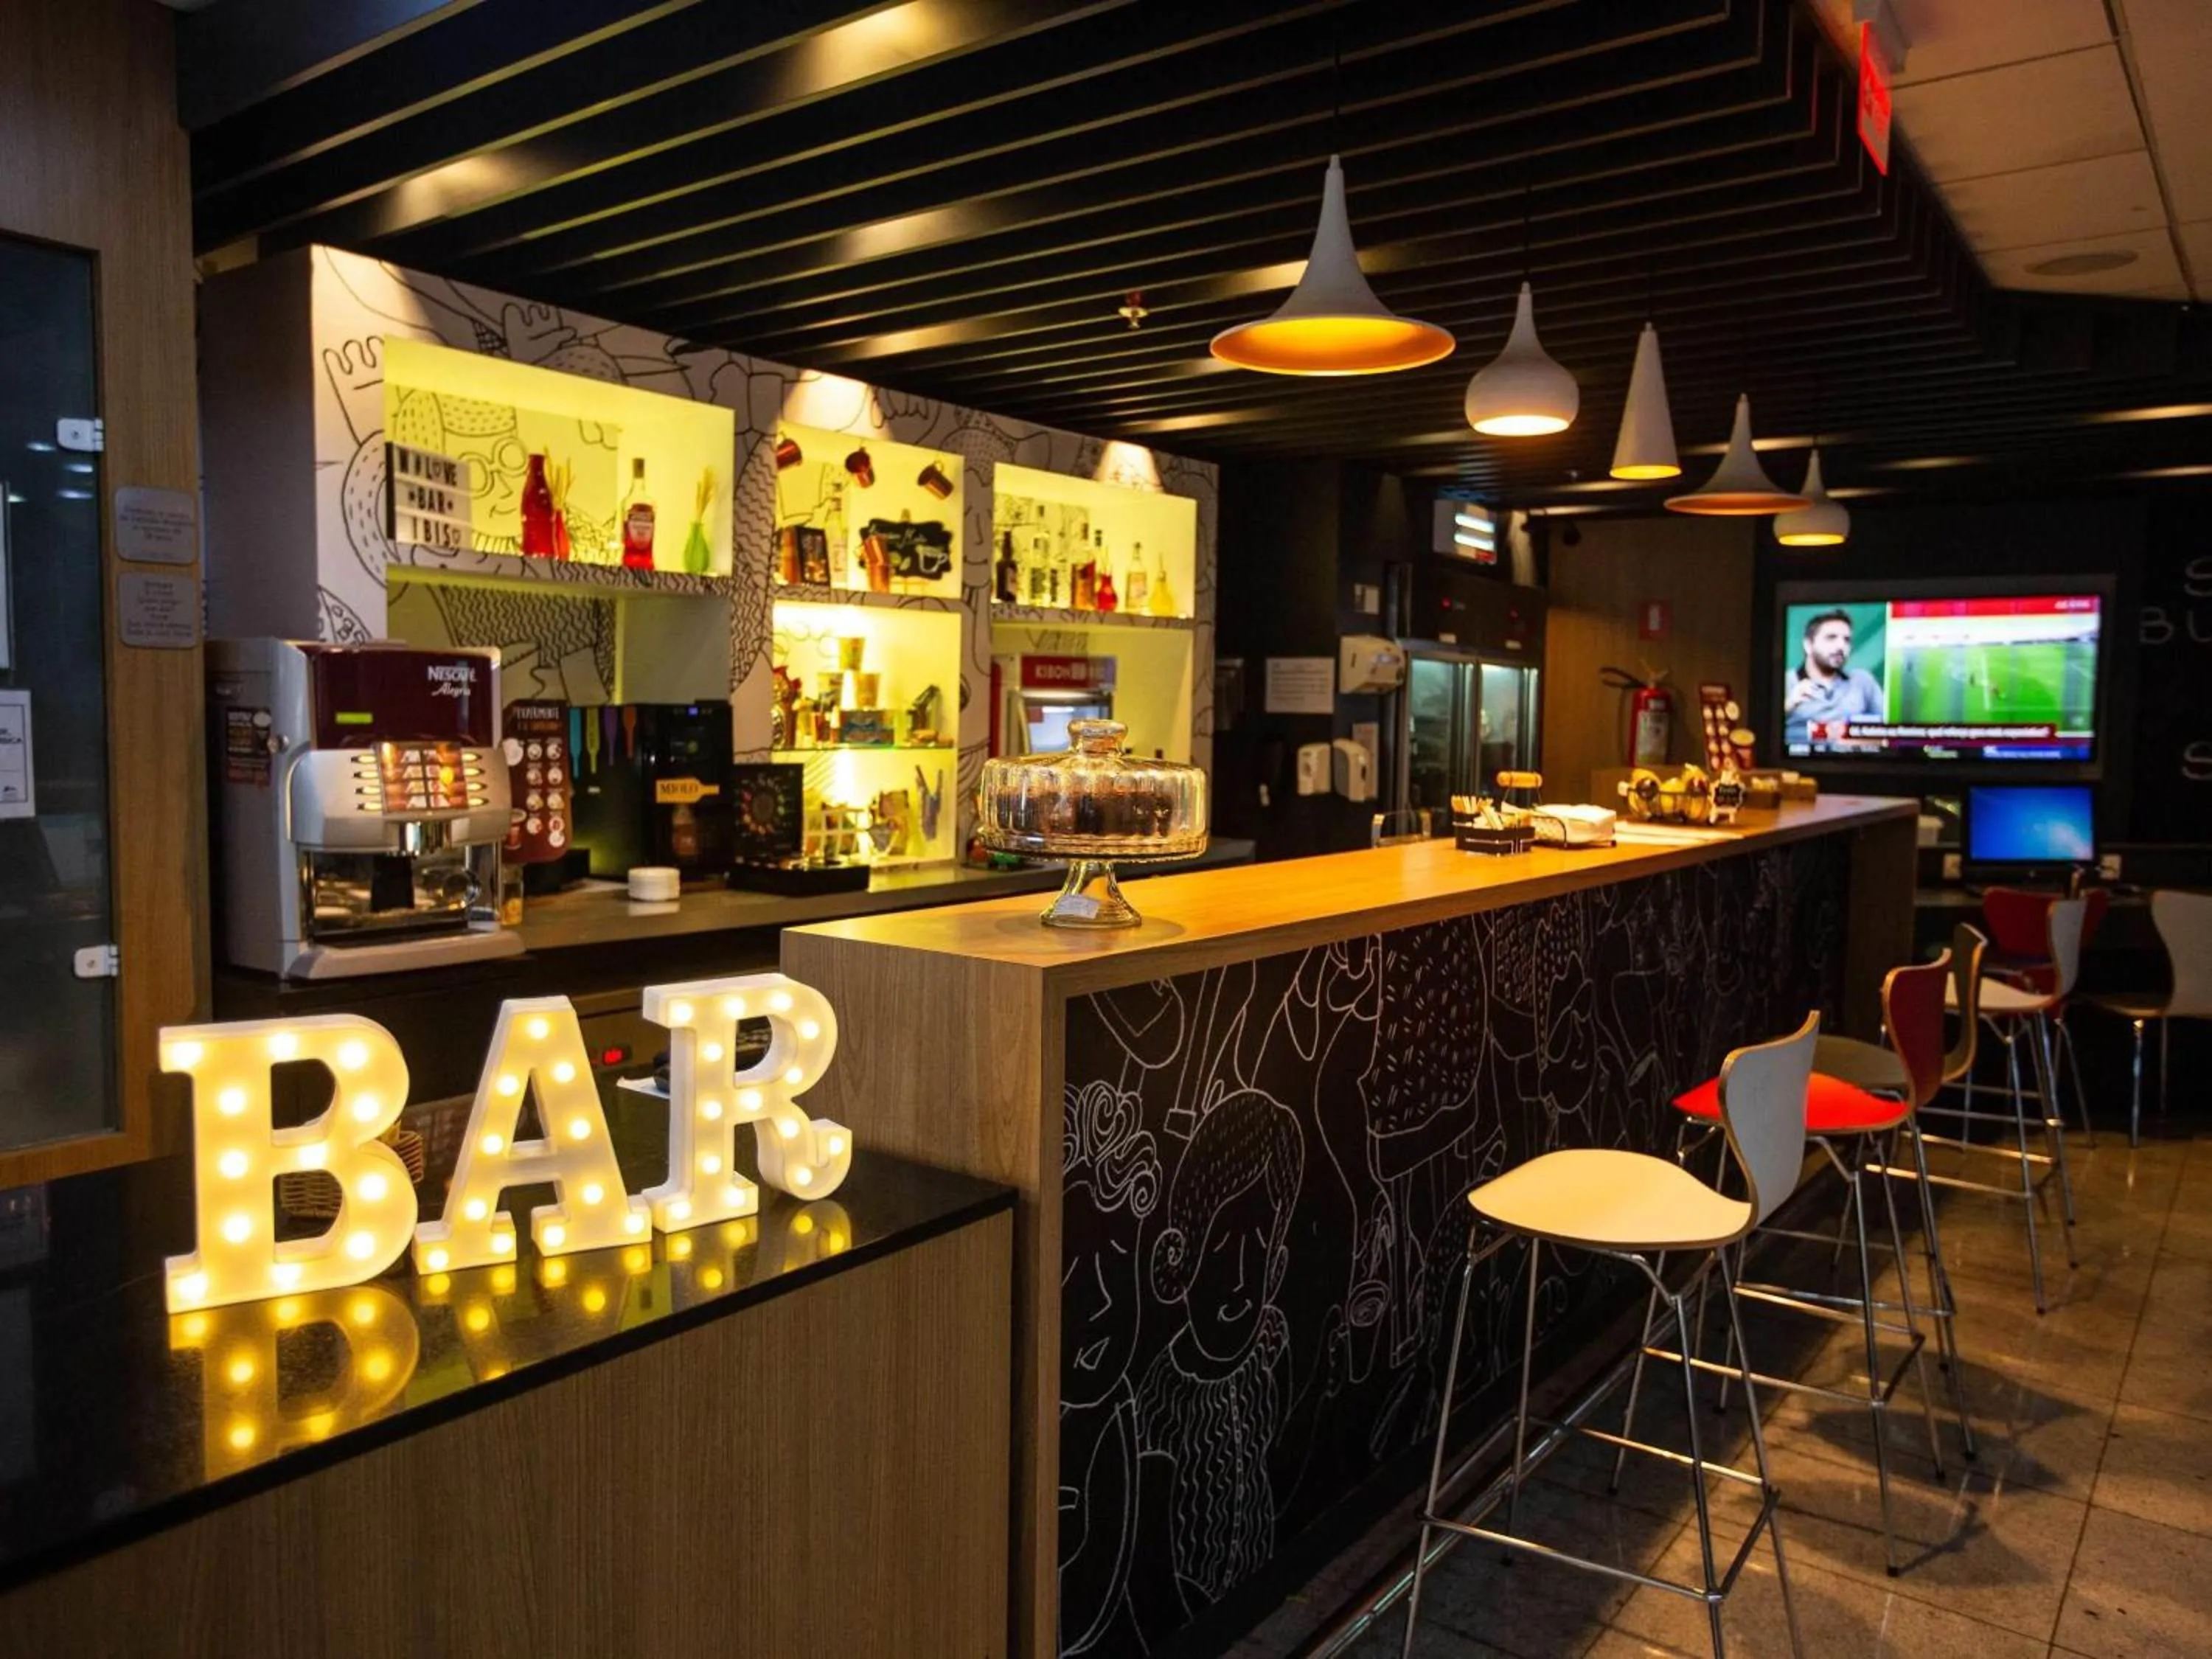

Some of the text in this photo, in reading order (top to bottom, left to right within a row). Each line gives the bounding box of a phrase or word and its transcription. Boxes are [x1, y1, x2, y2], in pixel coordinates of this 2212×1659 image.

[417, 486, 445, 514] BAR
[413, 516, 451, 548] IBIS
[159, 972, 852, 1314] BAR
